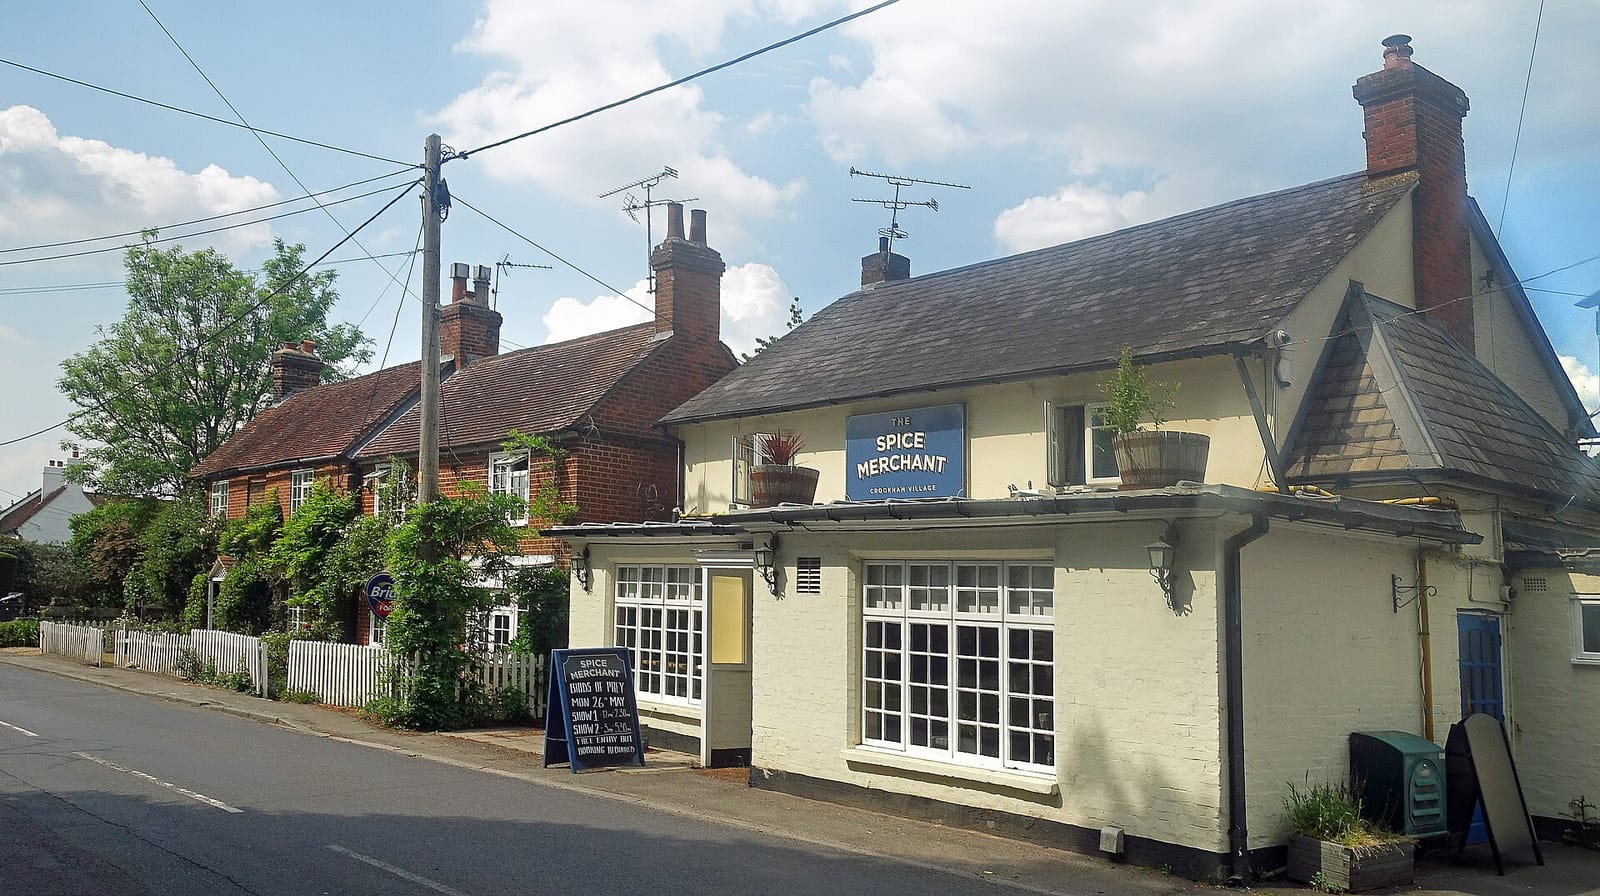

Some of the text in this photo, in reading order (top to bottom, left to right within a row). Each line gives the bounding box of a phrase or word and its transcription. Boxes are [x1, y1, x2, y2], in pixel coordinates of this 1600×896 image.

[892, 417, 910, 426] THE
[876, 432, 926, 452] SPICE
[857, 454, 948, 480] MERCHANT
[869, 484, 937, 495] CROOKHAM VILLAGE
[580, 659, 607, 668] SPICE
[570, 668, 620, 680] MERCHANT
[569, 681, 625, 694] BIRDS OF PREY
[571, 697, 590, 707] MON
[609, 696, 625, 707] MAY
[571, 710, 592, 722] SHOW
[593, 709, 599, 721] 1
[573, 723, 594, 735] SHOW
[595, 723, 600, 734] 2
[576, 735, 633, 745] FREE ENTRY BUT
[577, 745, 636, 756] BOOKING REQUIRED
